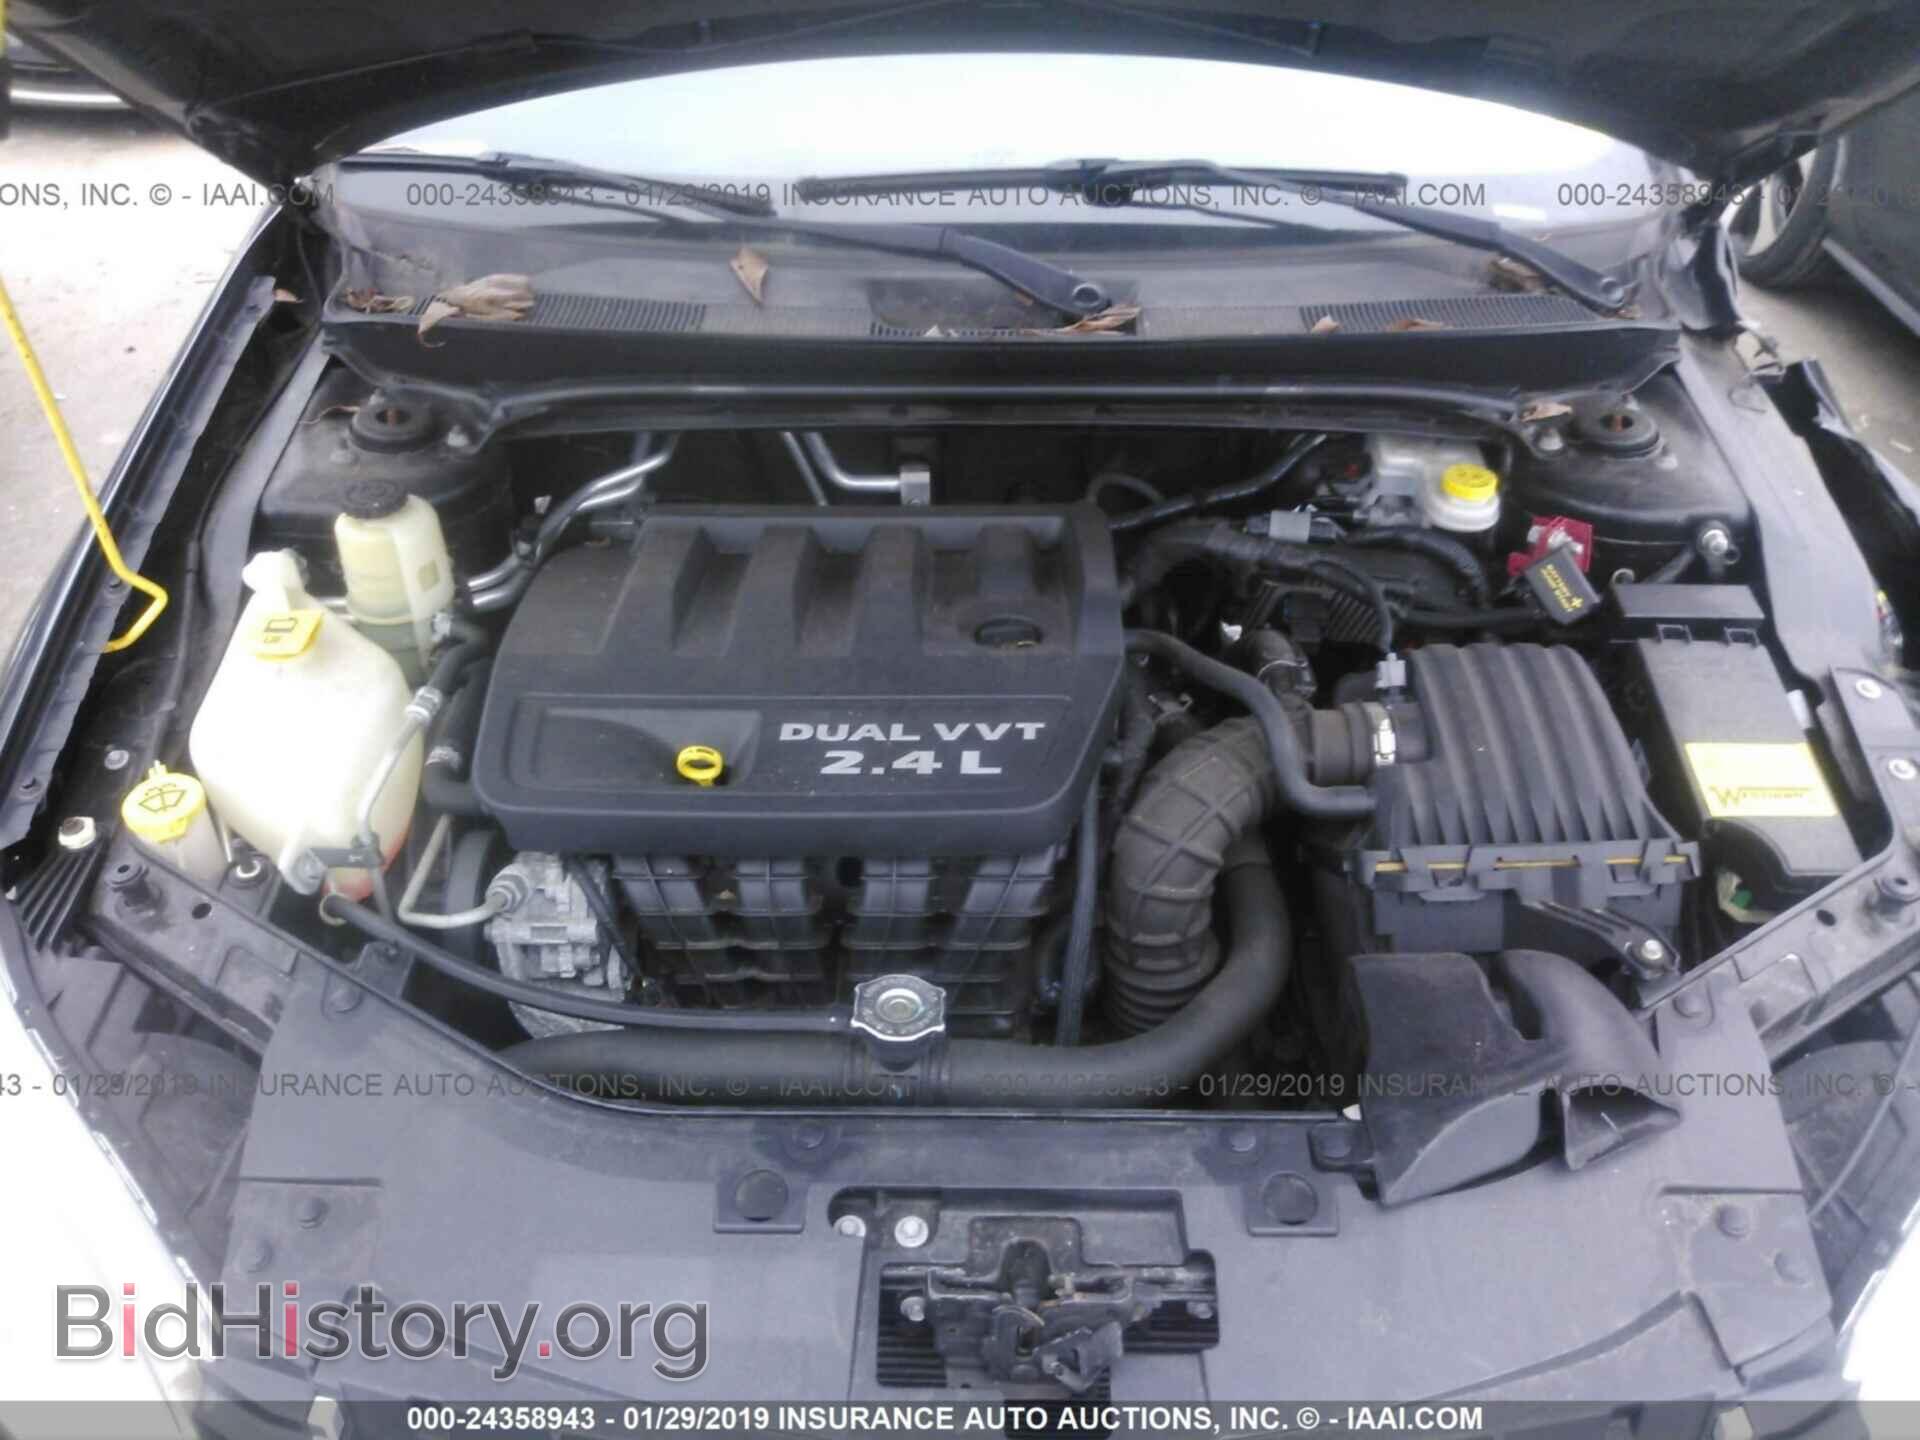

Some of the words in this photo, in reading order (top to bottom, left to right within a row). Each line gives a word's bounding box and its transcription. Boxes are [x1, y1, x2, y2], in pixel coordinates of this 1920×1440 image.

[779, 723, 920, 742] DUAL
[933, 722, 1046, 741] VVT
[820, 750, 943, 775] 2.4
[960, 750, 1002, 775] L
